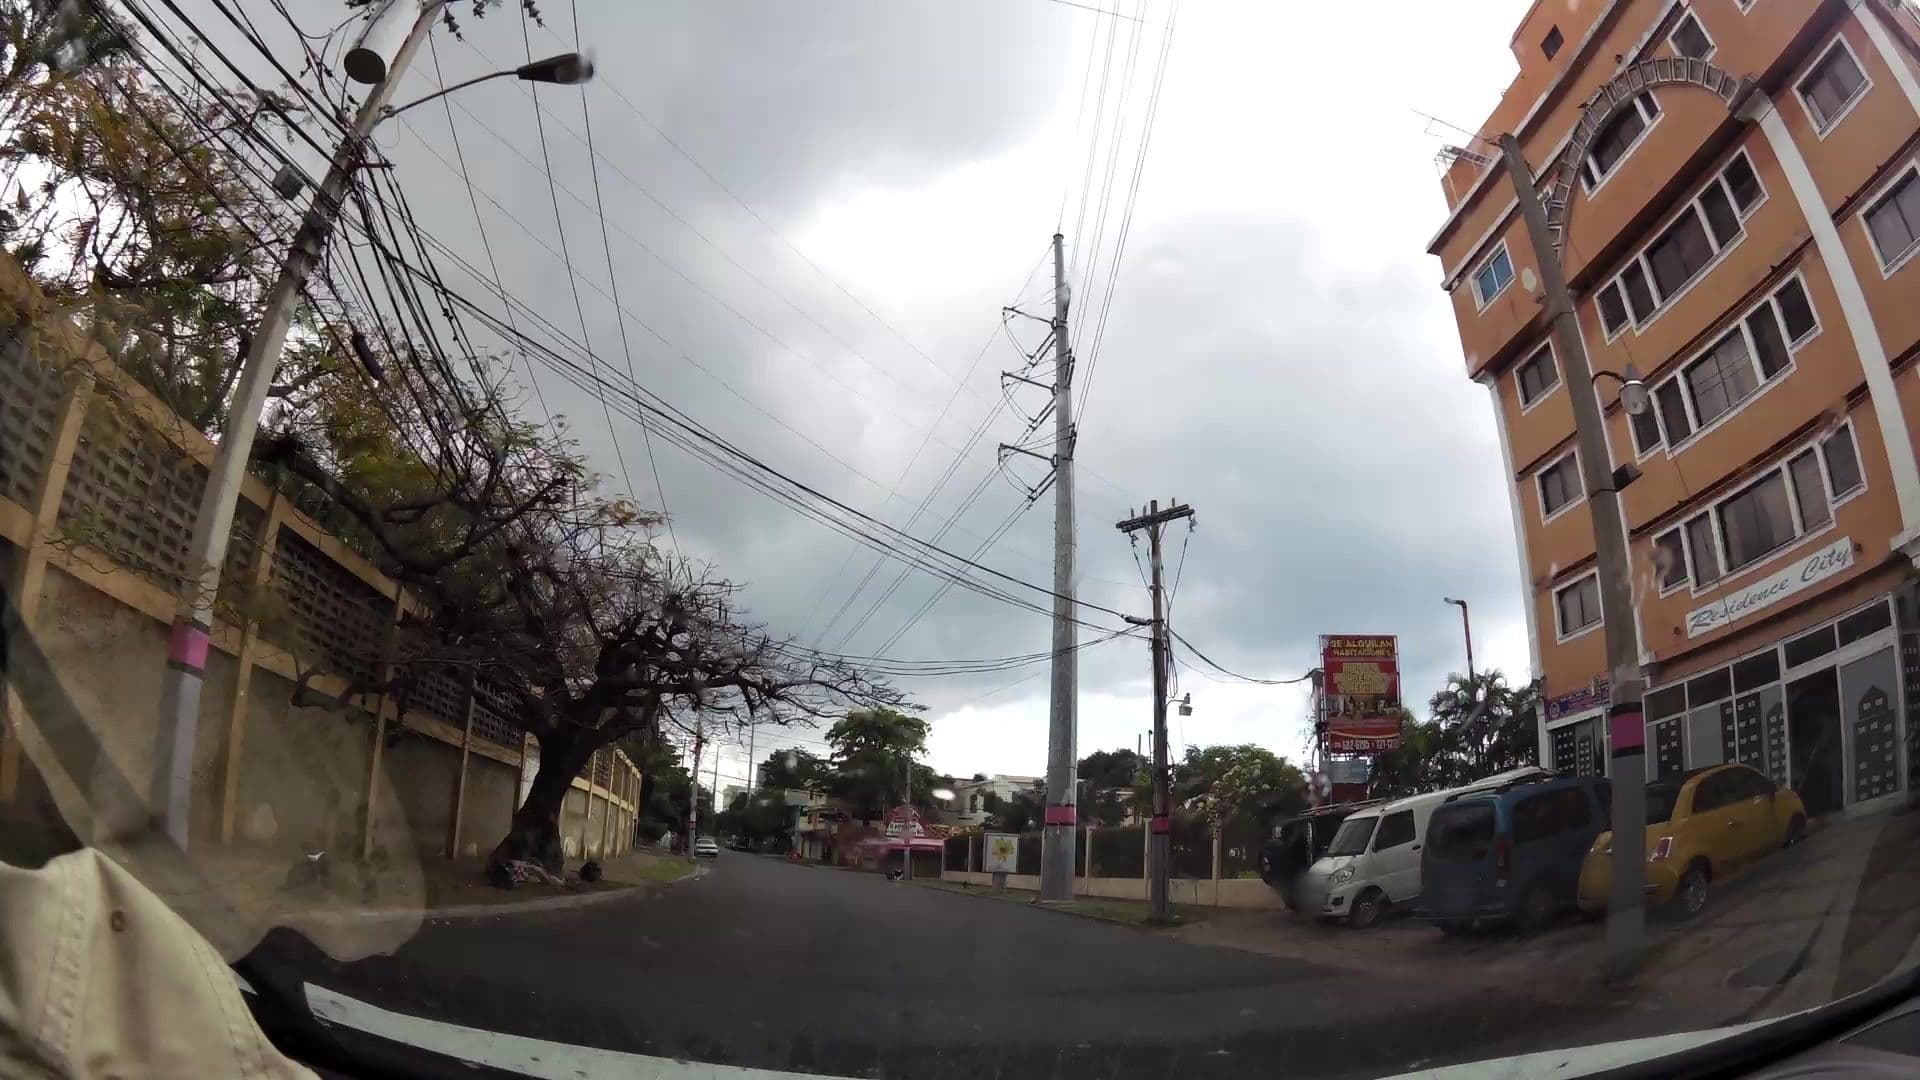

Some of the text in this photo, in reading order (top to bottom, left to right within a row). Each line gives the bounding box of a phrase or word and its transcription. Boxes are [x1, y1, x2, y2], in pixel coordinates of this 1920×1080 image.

[1690, 548, 1850, 632] Residence City
[1330, 639, 1344, 648] SE
